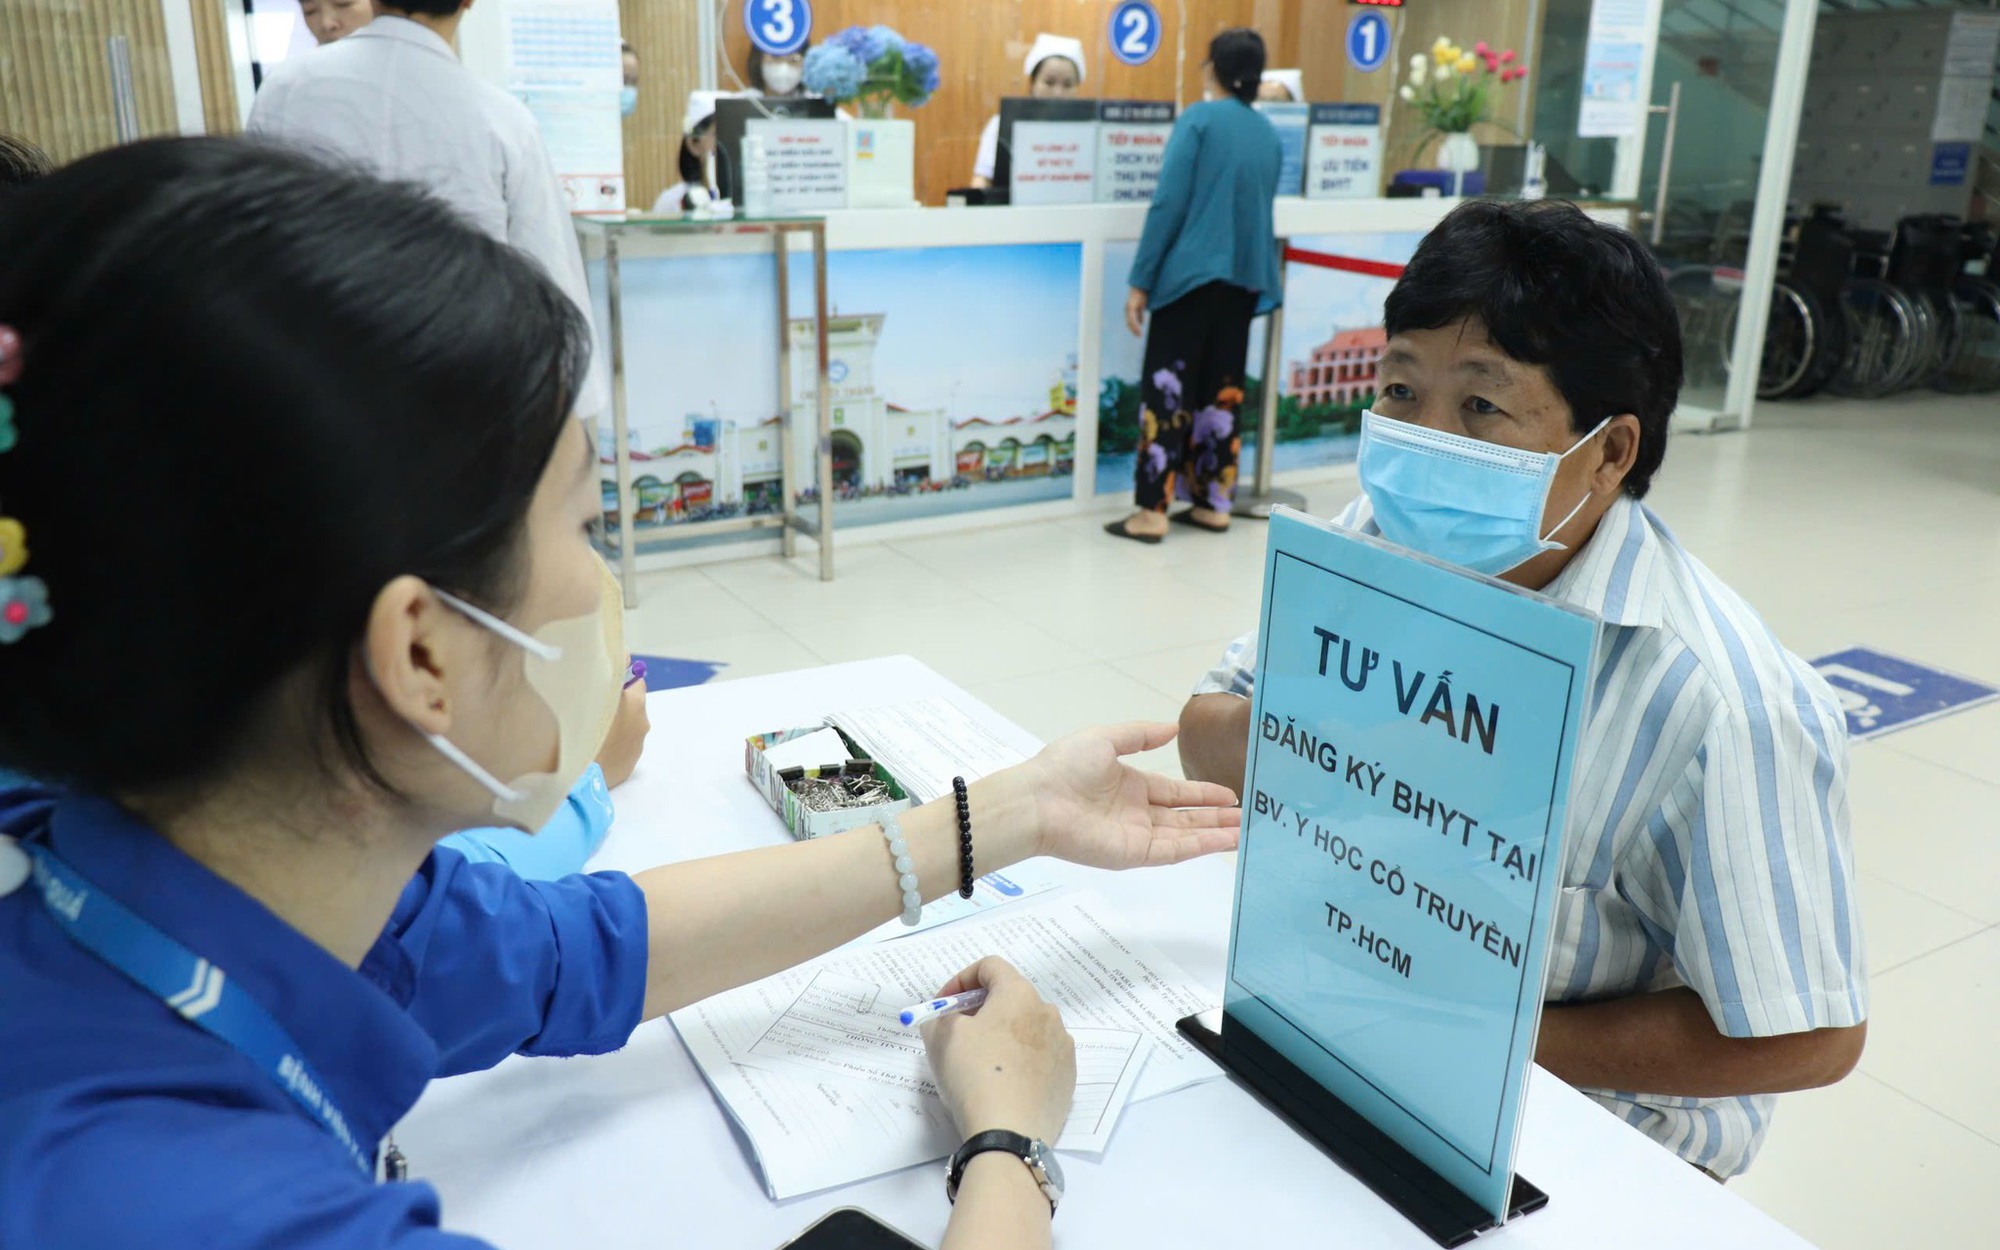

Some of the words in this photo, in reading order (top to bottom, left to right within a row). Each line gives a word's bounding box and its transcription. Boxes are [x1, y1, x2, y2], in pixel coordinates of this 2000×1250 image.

[762, 0, 794, 43] 3
[1121, 9, 1148, 54] 2
[1359, 20, 1377, 61] 1
[1313, 625, 1379, 692] TƯ
[1392, 659, 1500, 755] VẤN
[1261, 711, 1338, 773] ĐĂNG
[1345, 754, 1386, 797] KÝ
[1392, 779, 1478, 847] BHYT
[1486, 830, 1537, 882] TẠI
[1254, 789, 1287, 828] BV.
[1295, 811, 1309, 837] Y
[1314, 823, 1363, 871] HỌC
[1413, 881, 1522, 968] TRUYỀN
[1324, 901, 1412, 979] TP.HCM
